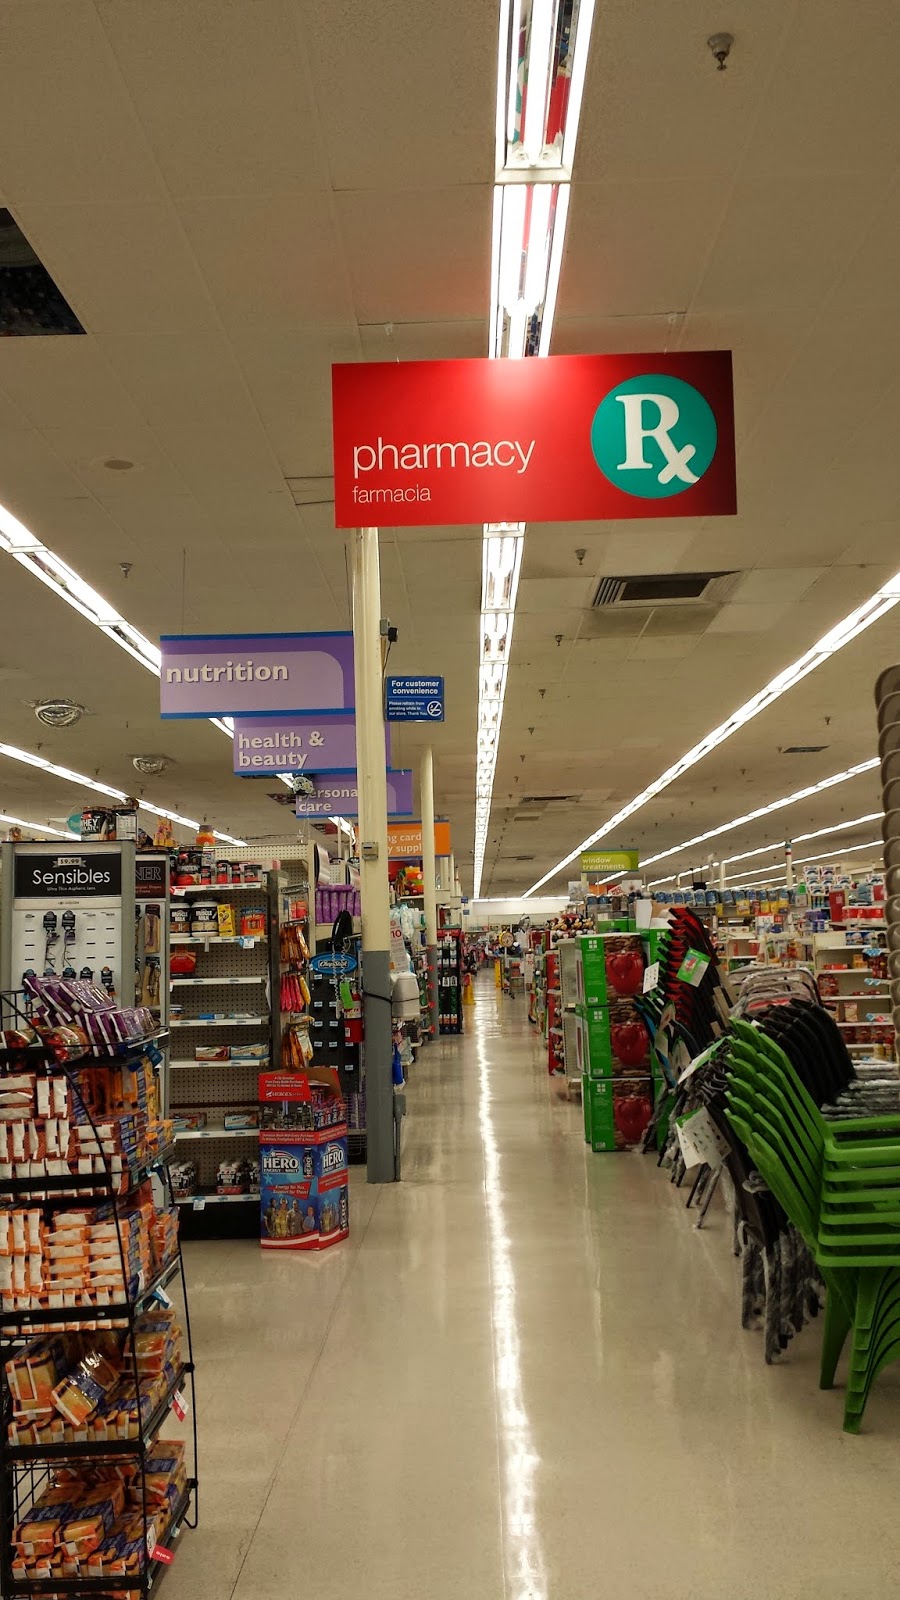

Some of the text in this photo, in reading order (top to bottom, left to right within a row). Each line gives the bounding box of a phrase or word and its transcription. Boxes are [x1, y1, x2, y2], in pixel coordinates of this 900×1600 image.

[352, 437, 536, 479] pharmacy
[352, 484, 431, 504] farmacia
[165, 661, 289, 683] nutrition
[238, 731, 325, 750] health &
[238, 751, 308, 769] beauty
[299, 788, 358, 801] persona
[298, 802, 332, 812] care
[32, 869, 111, 885] Sensibles
[390, 930, 402, 938] 10
[263, 1157, 299, 1169] HERO
[323, 1150, 344, 1168] HERO
